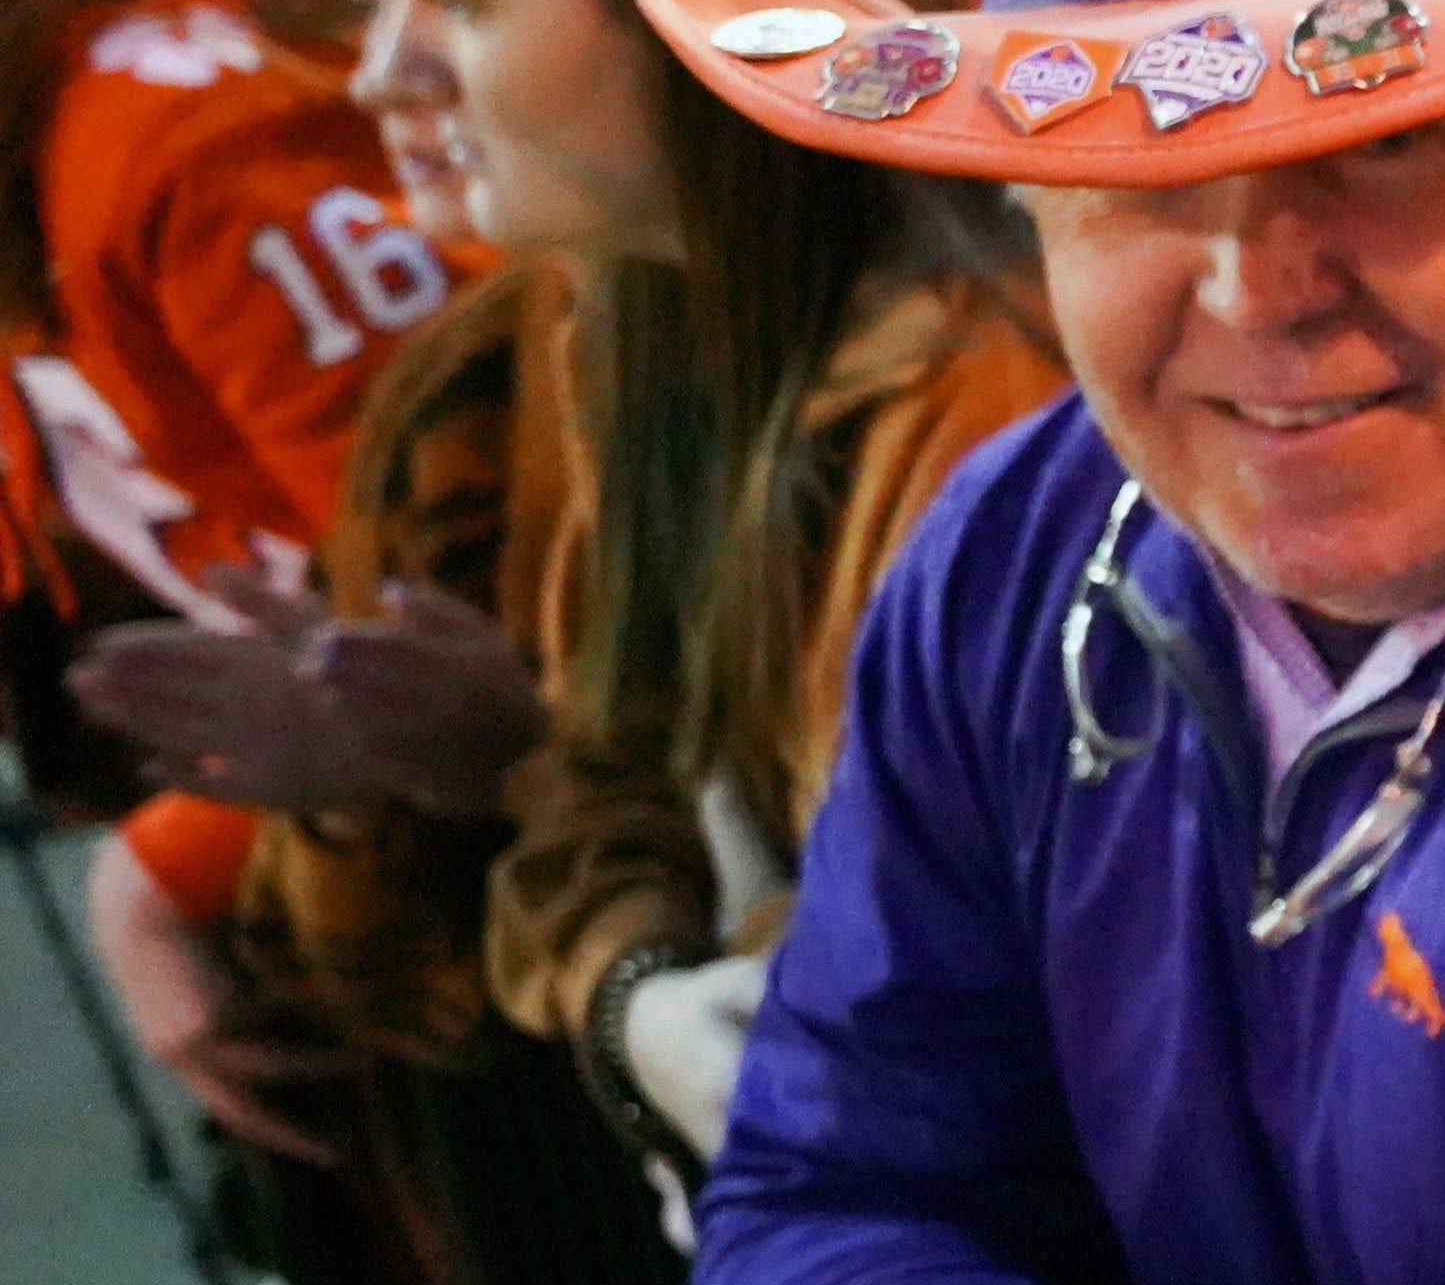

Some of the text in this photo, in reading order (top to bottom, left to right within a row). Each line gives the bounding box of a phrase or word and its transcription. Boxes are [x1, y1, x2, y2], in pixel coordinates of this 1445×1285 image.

[1009, 65, 1091, 94] 2020
[1130, 39, 1260, 95] 2020
[248, 185, 449, 366] 16
